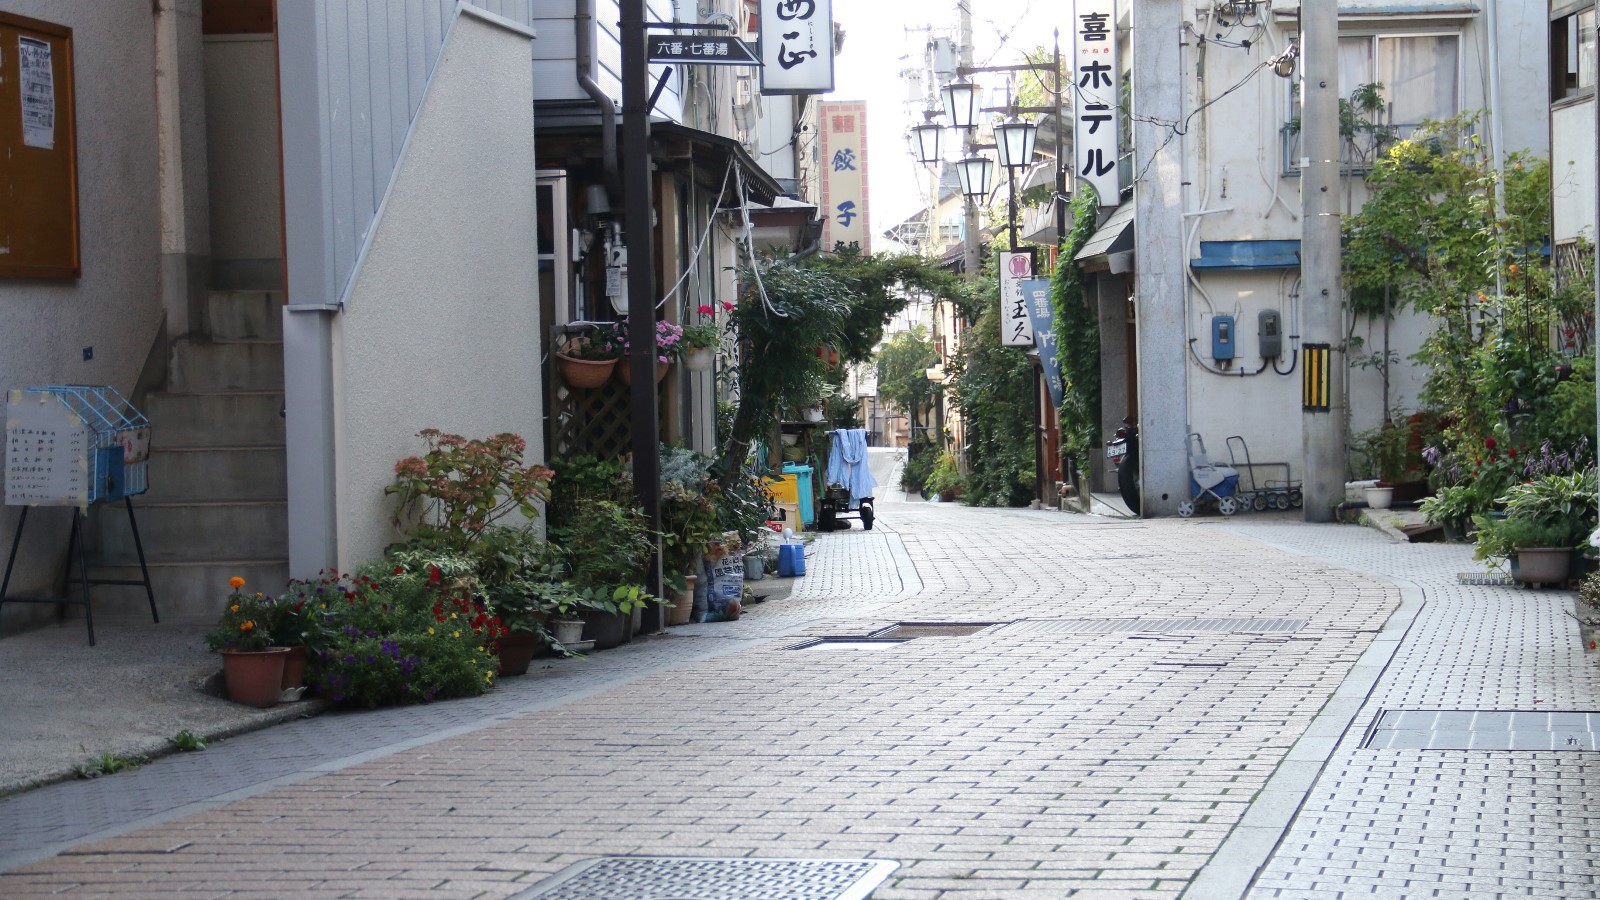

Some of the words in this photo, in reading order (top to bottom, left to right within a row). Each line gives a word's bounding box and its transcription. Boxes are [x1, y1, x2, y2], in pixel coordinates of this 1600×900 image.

[657, 42, 729, 56] 六番・七番湯
[831, 148, 858, 228] 餃子
[1011, 299, 1031, 342] 玉久
